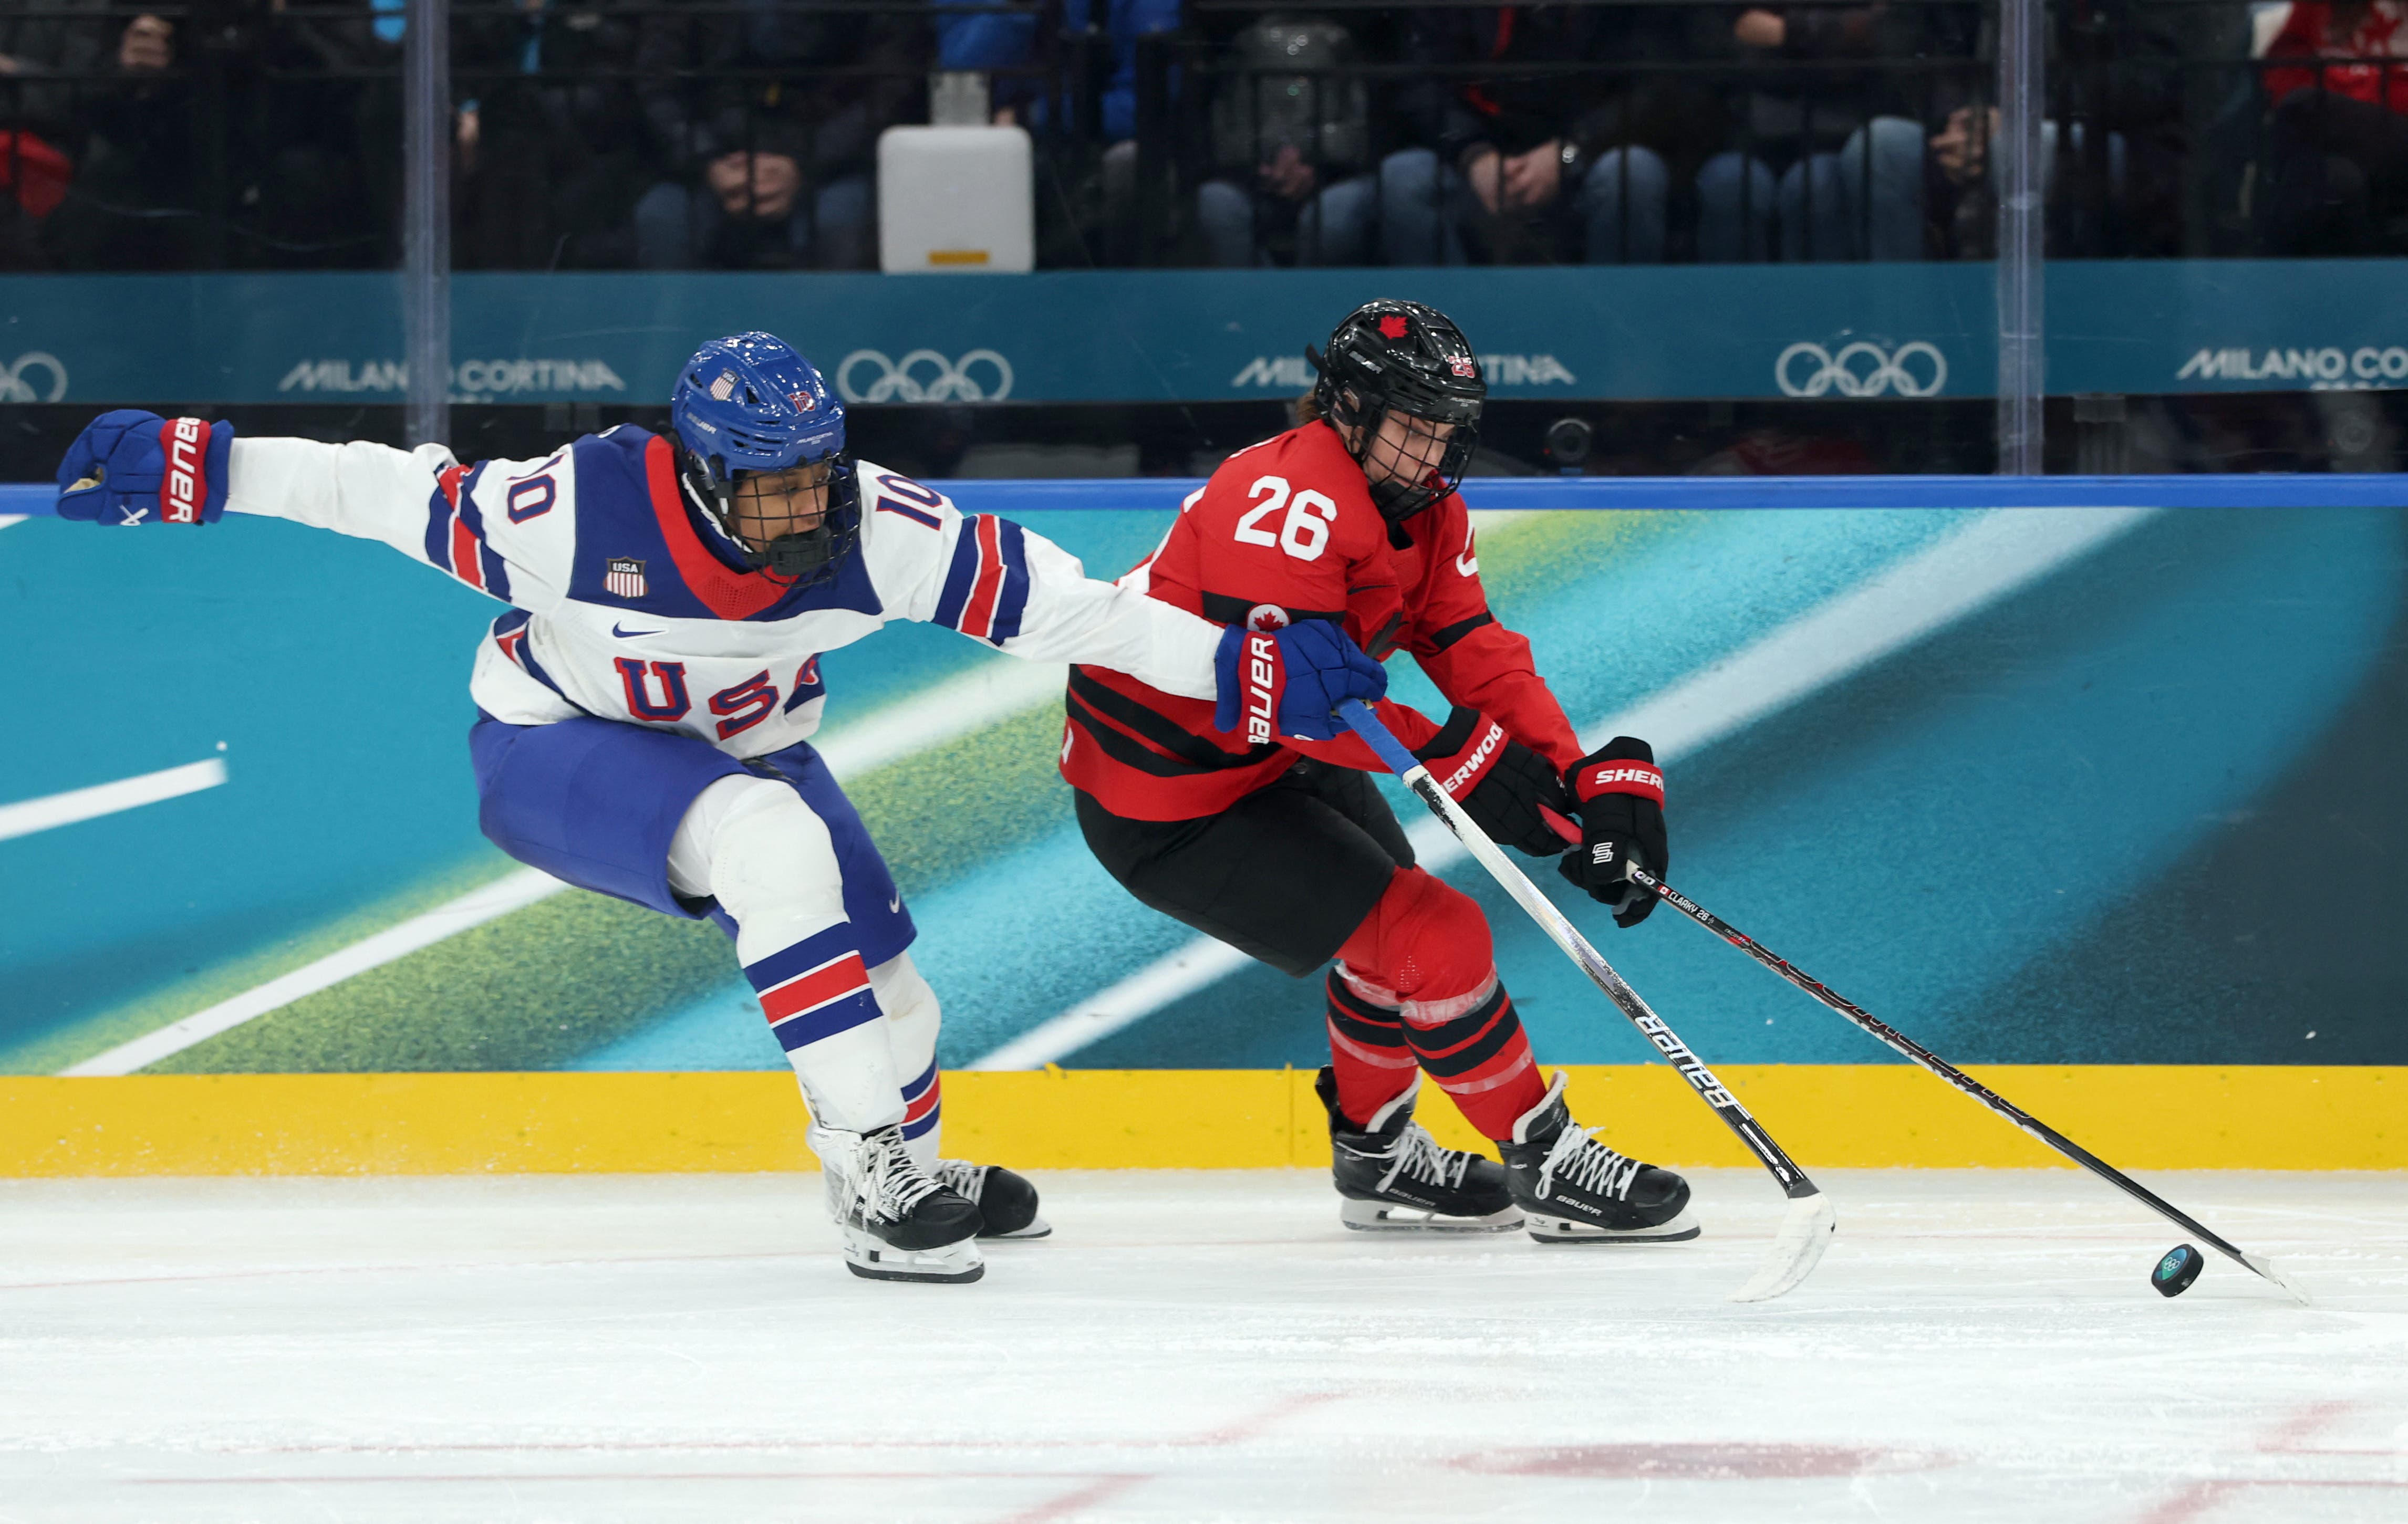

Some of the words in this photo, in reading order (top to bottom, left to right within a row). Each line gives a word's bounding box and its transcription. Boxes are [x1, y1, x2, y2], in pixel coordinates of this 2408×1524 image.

[277, 359, 453, 392] MILAN
[459, 359, 627, 392] CORTINA
[722, 372, 735, 383] USA
[1231, 356, 1317, 388] MIL
[1478, 354, 1576, 385] TINA
[2174, 347, 2347, 380] MILANO
[787, 391, 816, 414] 10
[876, 474, 943, 531] 10
[1234, 475, 1337, 562] 26
[612, 562, 639, 573] USA
[1247, 637, 1274, 745] BAUER
[1440, 721, 1504, 794] ERWOO
[1668, 891, 1699, 913] CLARKY
[1696, 910, 1710, 921] 26
[1635, 1014, 1737, 1109] BAUER
[1388, 1188, 1436, 1207] BAUER
[1555, 1195, 1603, 1217] BAUER
